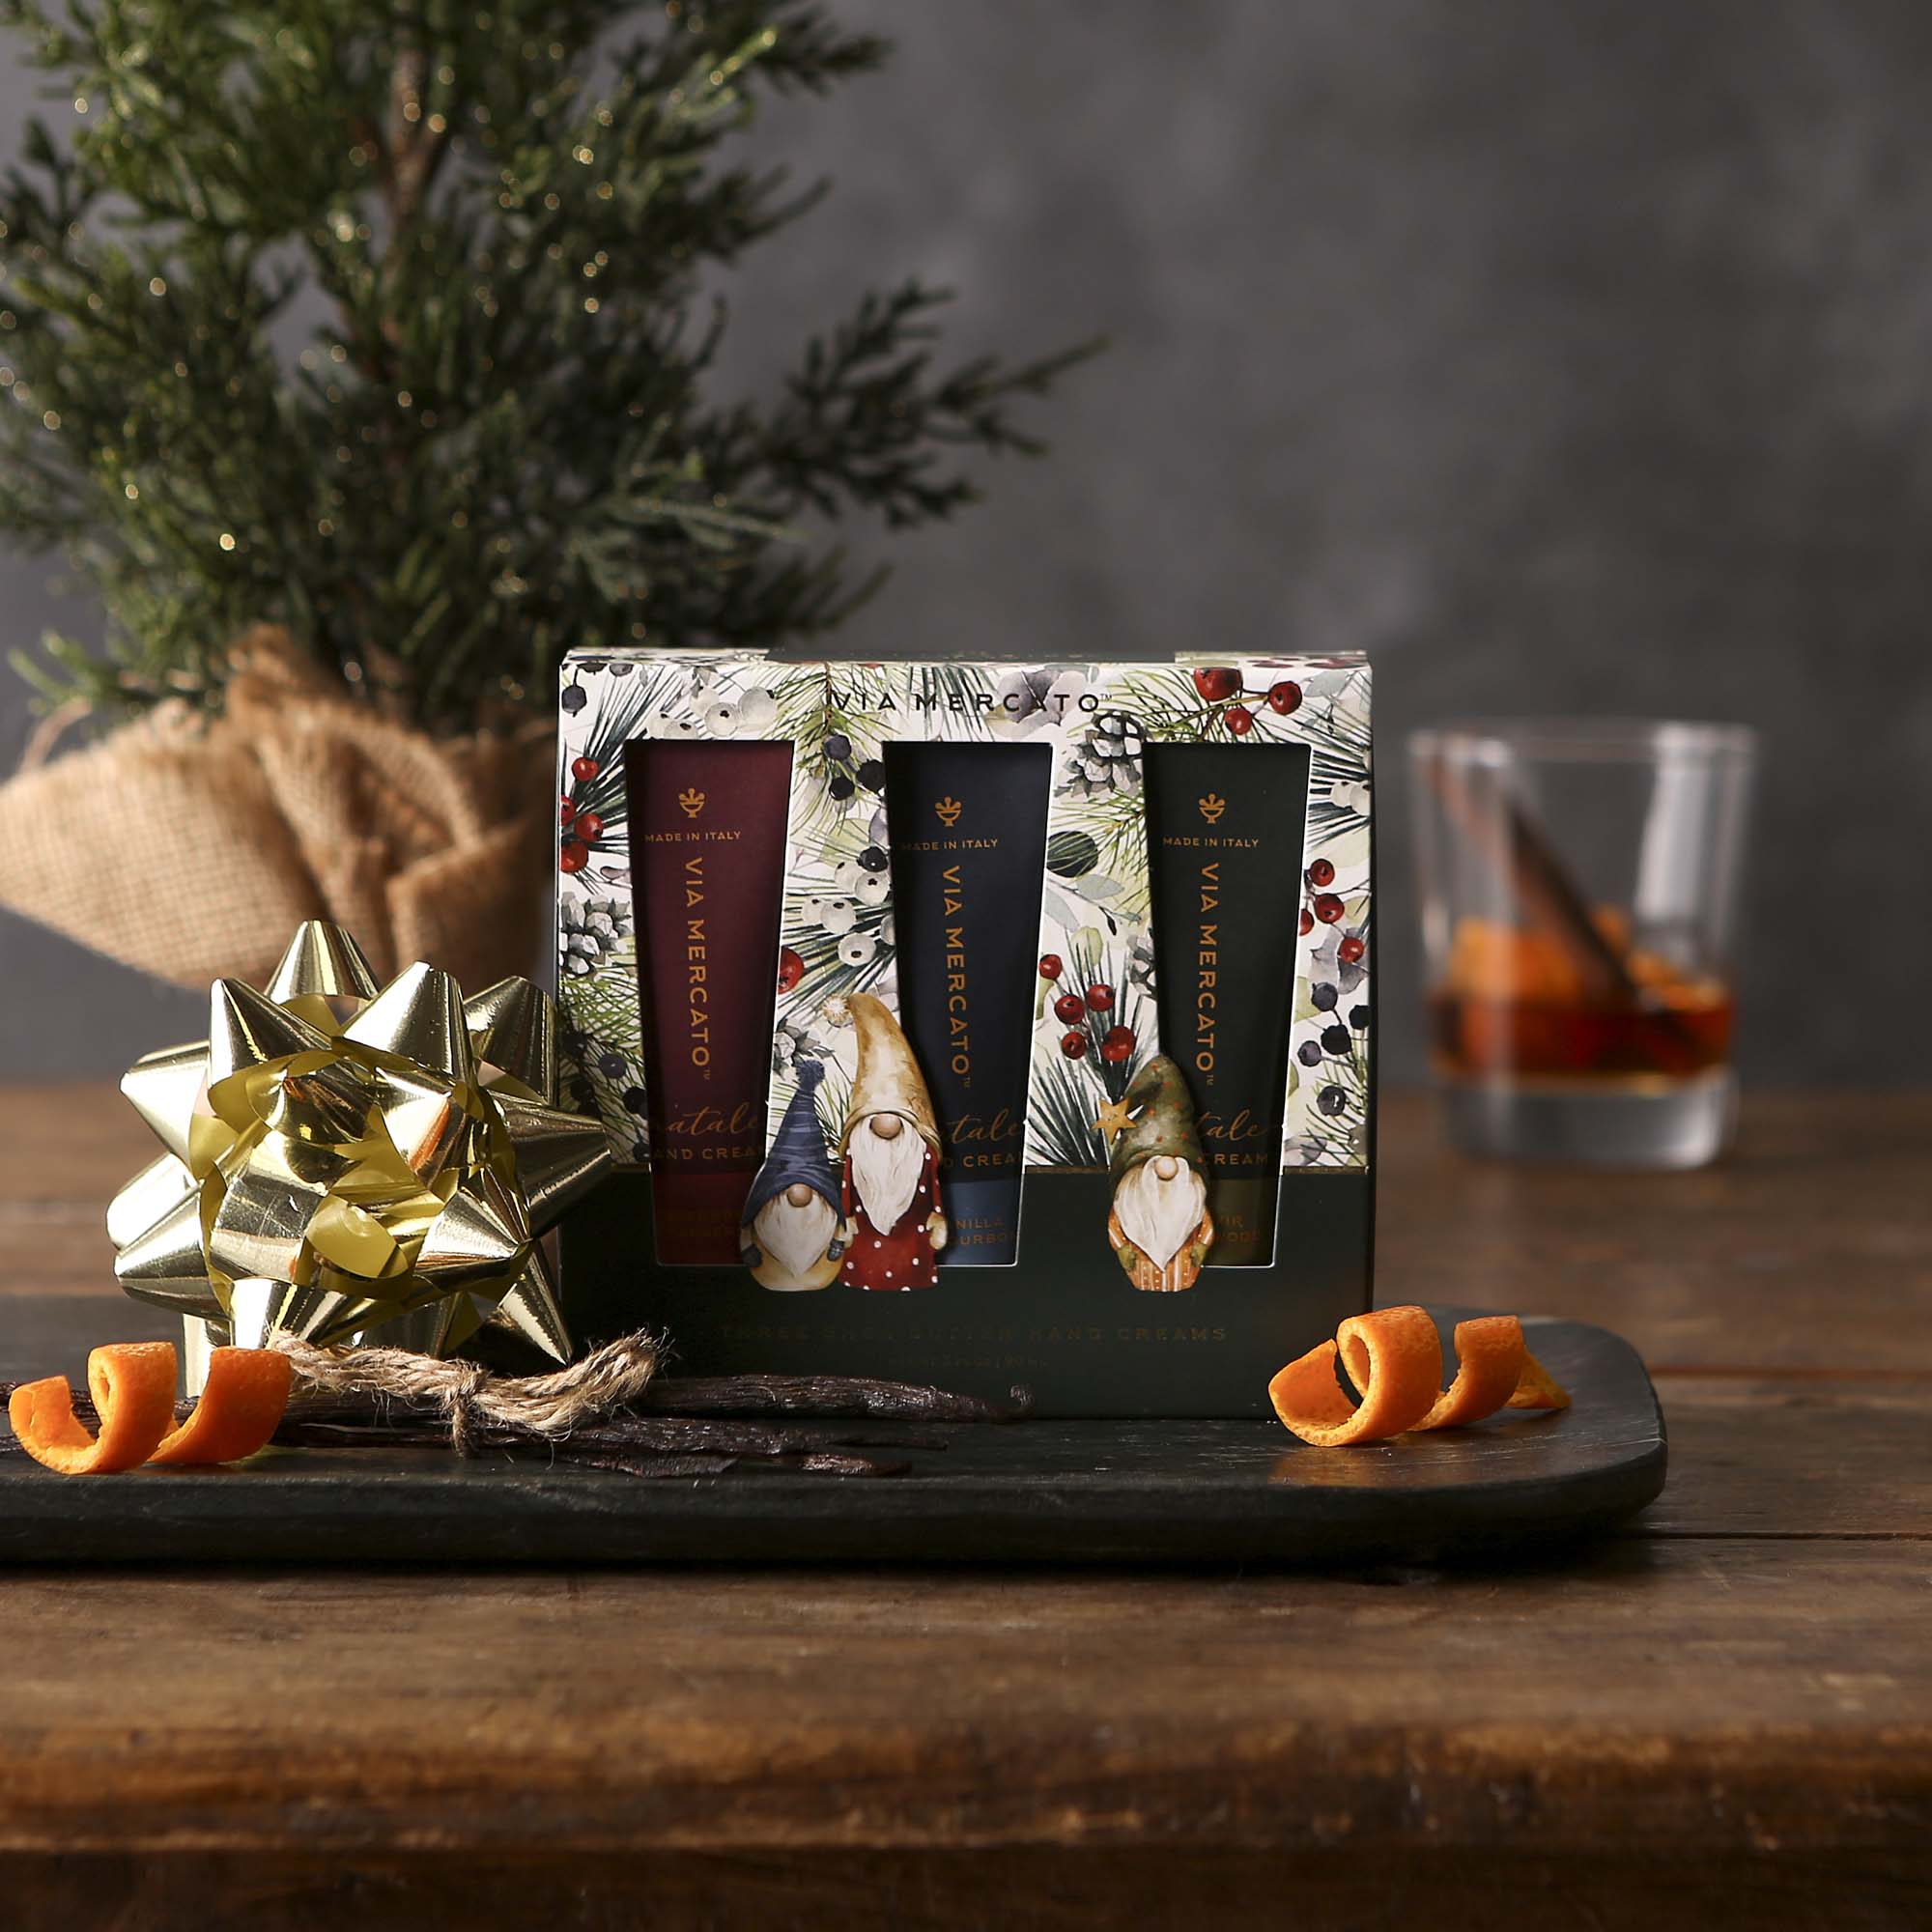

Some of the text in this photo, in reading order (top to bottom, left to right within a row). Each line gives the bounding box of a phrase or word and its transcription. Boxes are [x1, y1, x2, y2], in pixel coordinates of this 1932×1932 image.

[832, 693, 896, 711] VIA
[644, 833, 681, 842] MADE
[705, 831, 741, 840] ITALY
[1163, 838, 1260, 847] MADE IN ITALY
[900, 842, 939, 851] MADE
[962, 839, 998, 848] ITALY
[685, 857, 704, 907] VIA
[1201, 863, 1219, 912] VIA
[943, 866, 962, 916] VIA
[963, 1153, 1021, 1168] CREA
[1206, 1153, 1267, 1165] REAM
[1117, 1327, 1228, 1342] CREAMS
